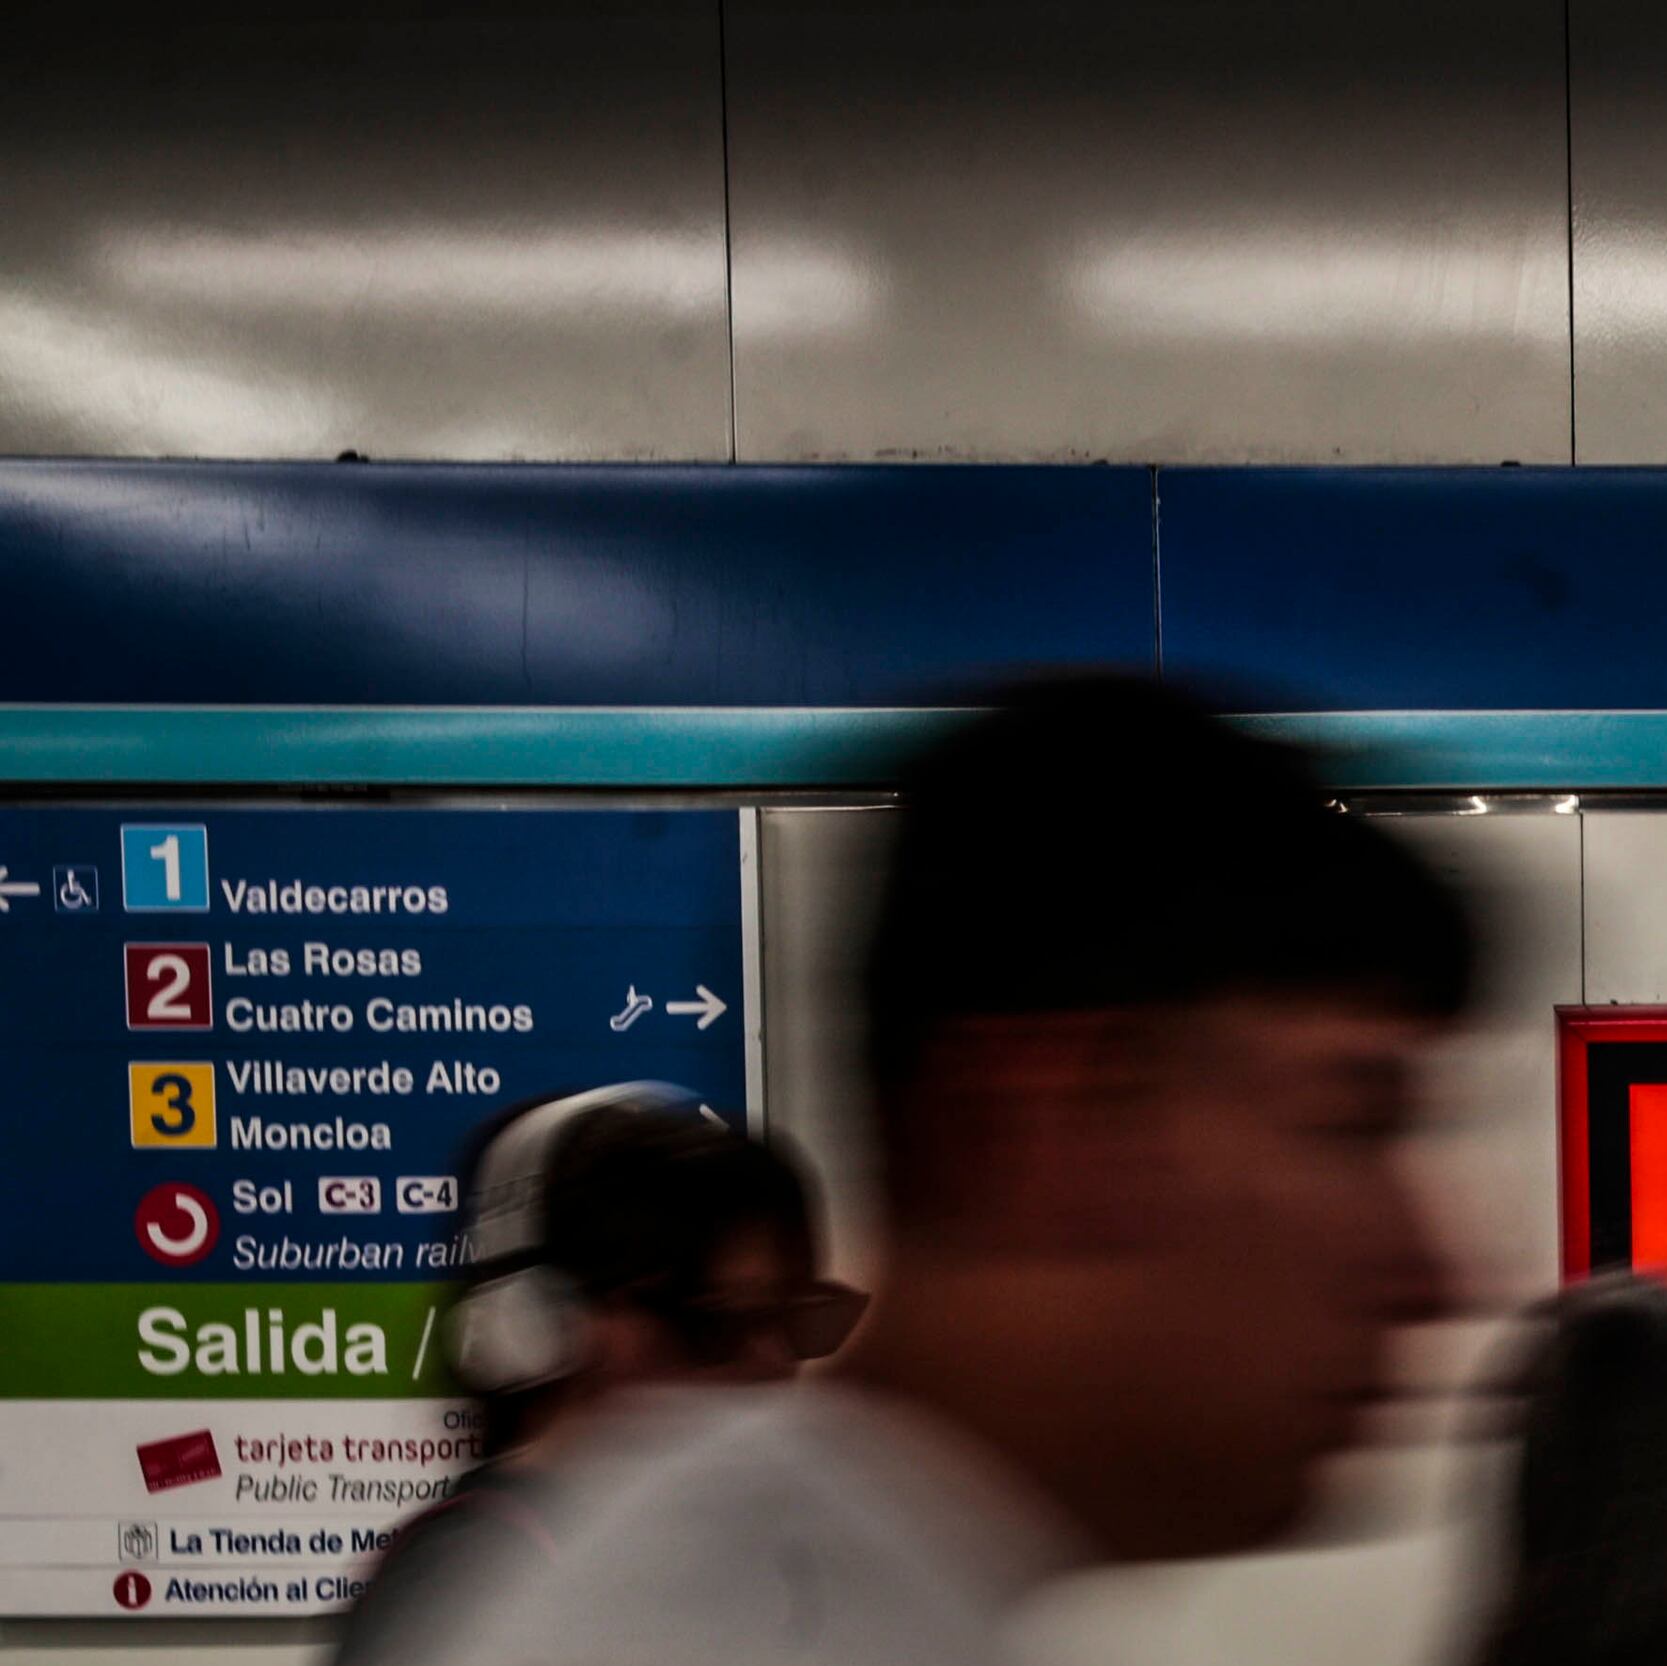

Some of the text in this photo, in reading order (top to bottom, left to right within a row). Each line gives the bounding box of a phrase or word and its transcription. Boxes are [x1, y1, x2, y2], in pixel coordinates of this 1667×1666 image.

[150, 835, 181, 900] 1
[221, 879, 448, 914] Valdecarros
[224, 942, 422, 977] Las Rosas
[146, 954, 192, 1020] 2
[225, 997, 535, 1032] Cuatro Caminos
[226, 1060, 501, 1095] Villaverde Alto
[150, 1073, 196, 1137] 3
[230, 1116, 392, 1150] Moncloa
[232, 1179, 453, 1214] Sol C-3 C-4
[233, 1234, 402, 1270] Suburban
[137, 1306, 389, 1376] Salida
[234, 1433, 334, 1468] tarjeta
[235, 1473, 449, 1507] Public Transport
[169, 1529, 202, 1555] La
[209, 1529, 301, 1555] Tienda
[309, 1529, 343, 1555] de
[165, 1576, 279, 1602] Atención
[286, 1578, 308, 1600] al
